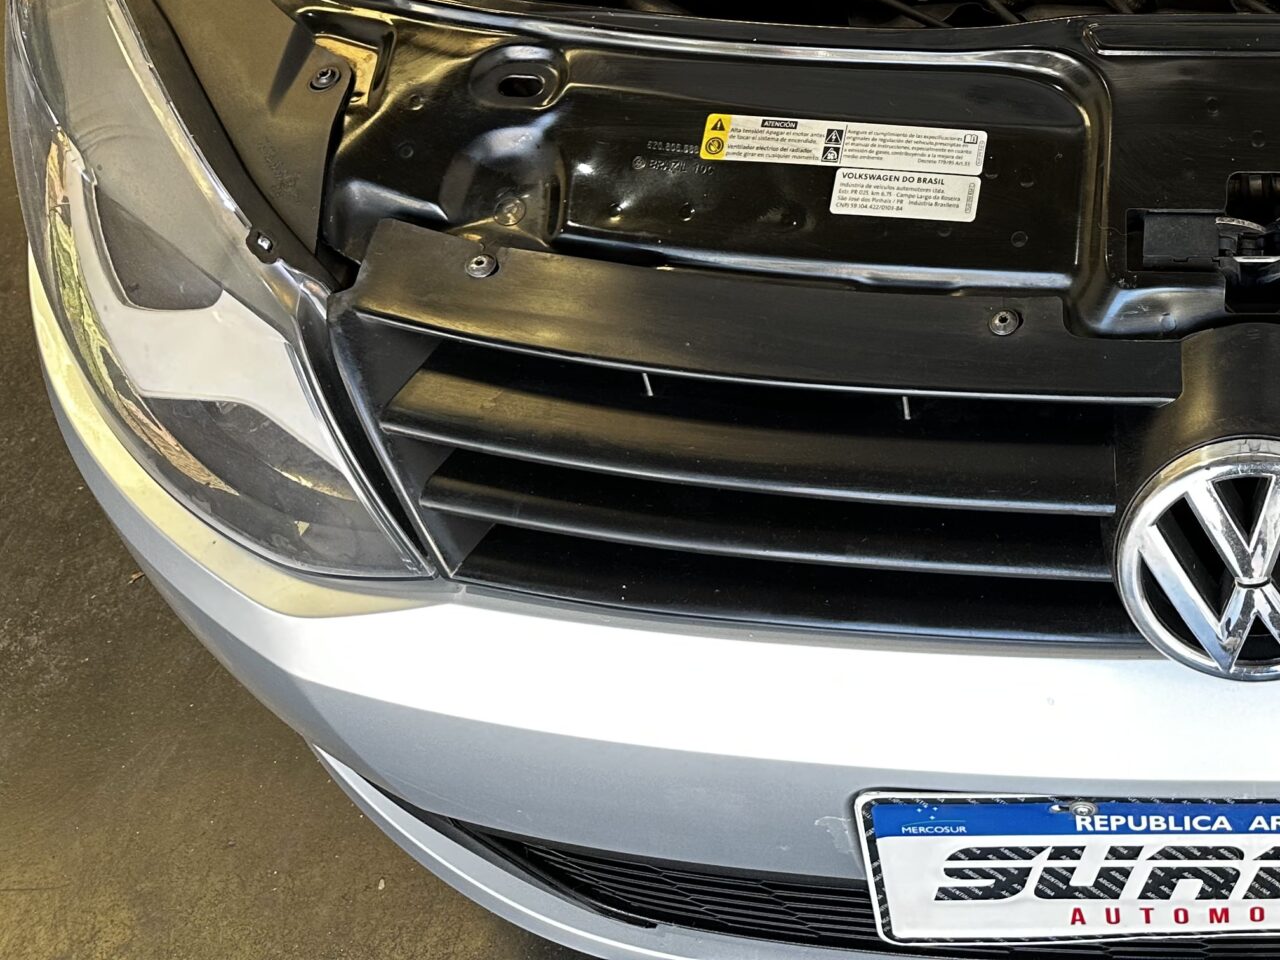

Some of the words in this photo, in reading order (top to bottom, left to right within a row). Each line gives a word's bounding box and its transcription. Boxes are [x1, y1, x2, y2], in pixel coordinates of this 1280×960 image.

[842, 172, 900, 183] VOLKSWAGEN
[902, 175, 915, 184] DO
[917, 177, 945, 186] BRASIL
[901, 824, 967, 834] MERCOSUR
[1075, 814, 1231, 832] REPUBLICA
